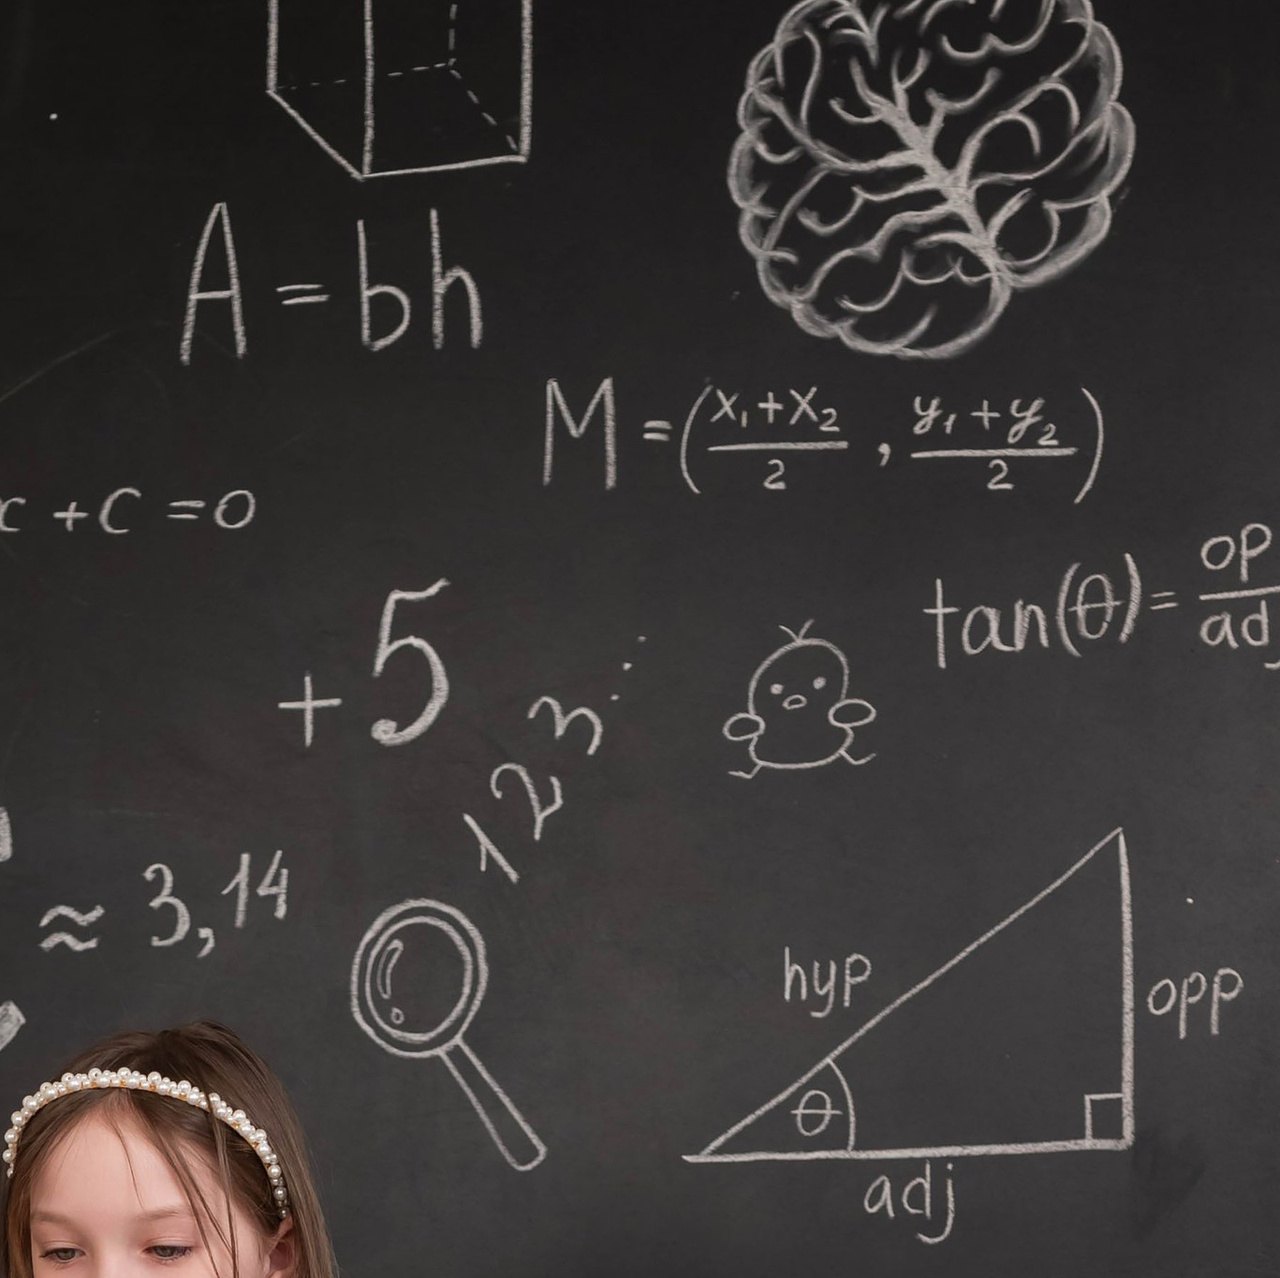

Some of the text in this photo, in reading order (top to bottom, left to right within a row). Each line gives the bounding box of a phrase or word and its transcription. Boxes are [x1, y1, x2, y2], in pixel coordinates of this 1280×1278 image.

[180, 202, 247, 365] A
[357, 208, 485, 353] bh
[543, 377, 616, 490] M
[784, 946, 872, 1018] hyp
[1147, 966, 1245, 1040] opp
[864, 1159, 956, 1245] adj
